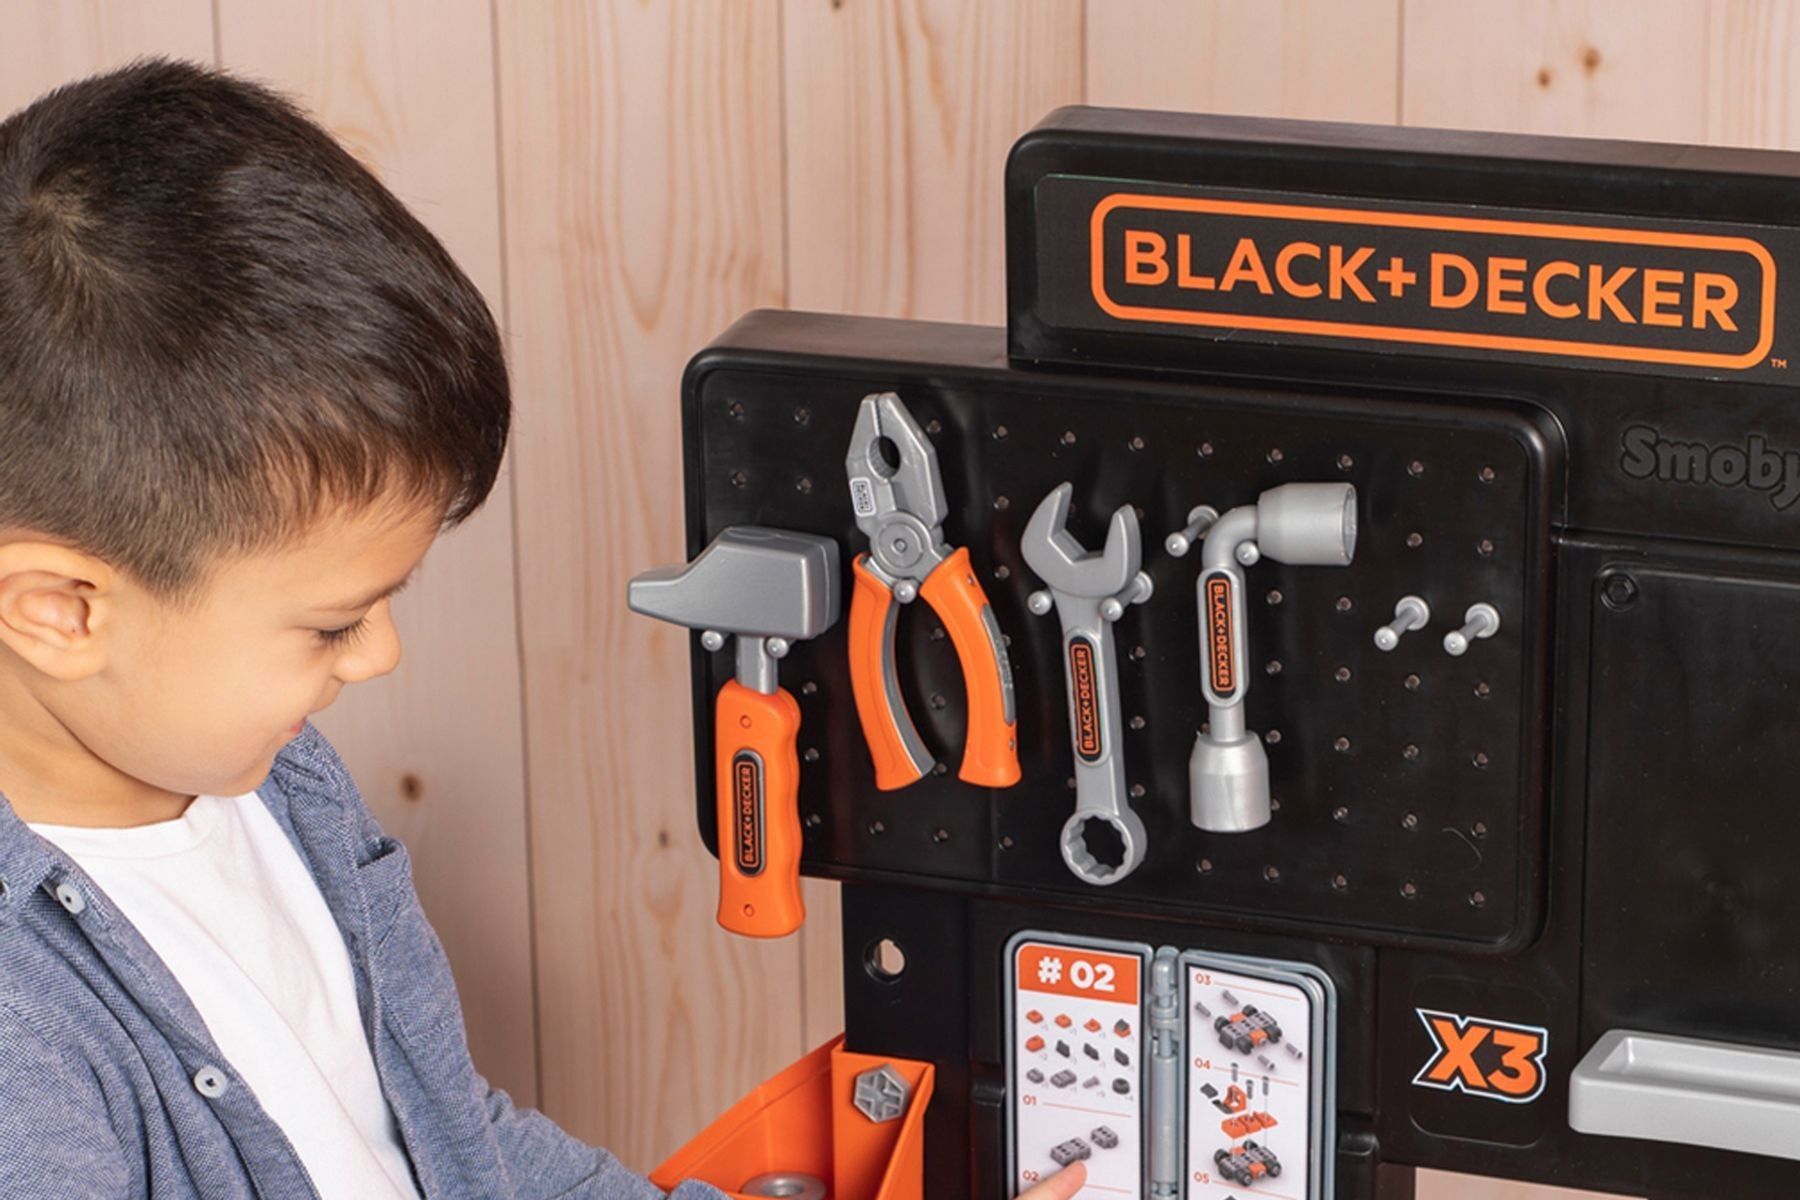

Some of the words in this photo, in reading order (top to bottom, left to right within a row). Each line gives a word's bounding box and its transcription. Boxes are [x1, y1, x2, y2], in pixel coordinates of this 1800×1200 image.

[1125, 229, 1741, 333] BLACK+DECKER
[1069, 960, 1116, 993] 02
[1194, 972, 1211, 986] 03
[1194, 1057, 1211, 1070] 04
[1426, 1017, 1541, 1096] X3
